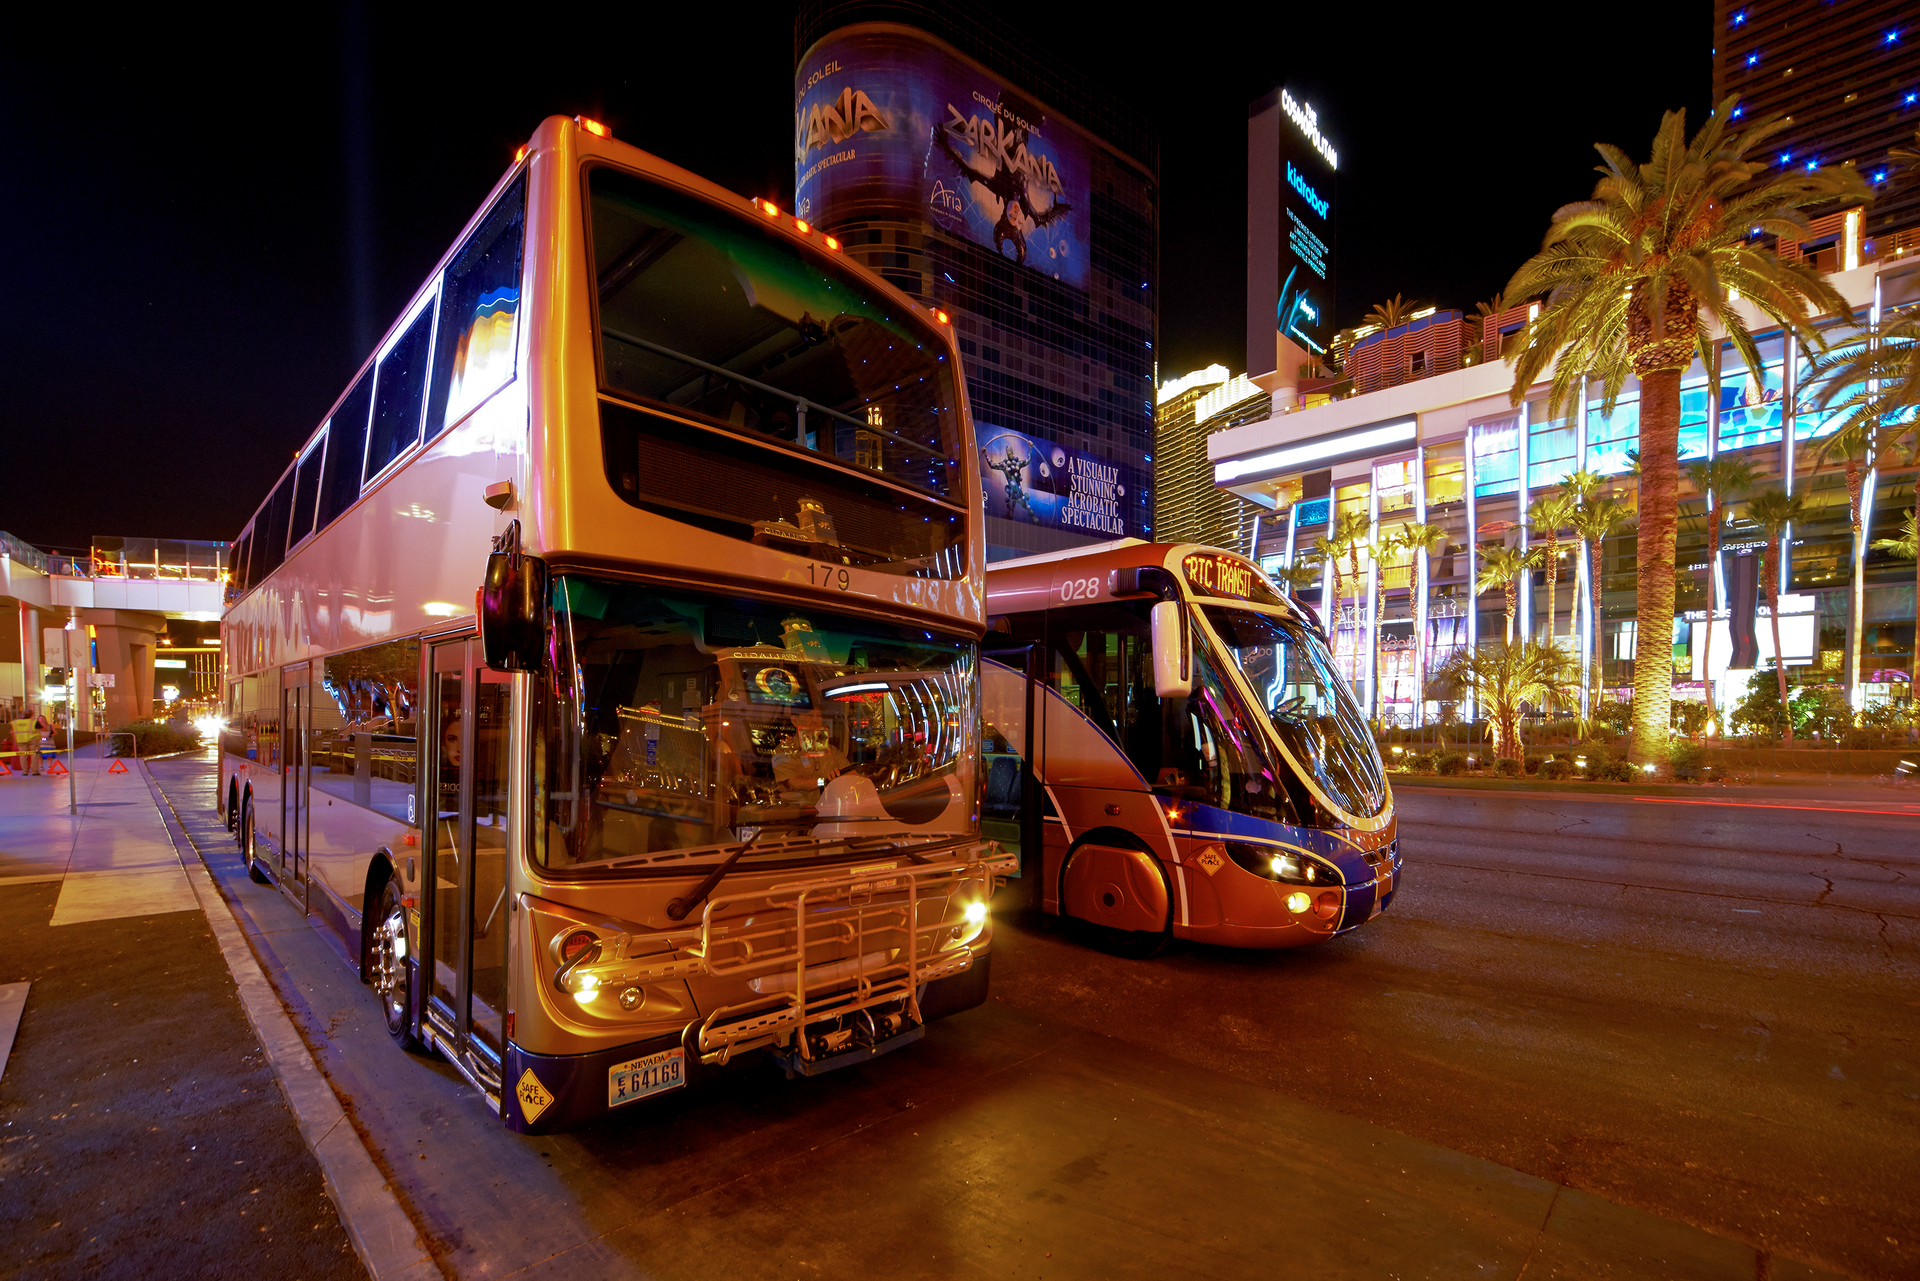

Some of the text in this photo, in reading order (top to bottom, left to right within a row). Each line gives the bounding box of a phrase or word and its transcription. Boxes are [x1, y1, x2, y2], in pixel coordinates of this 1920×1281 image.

[808, 60, 842, 90] SOLEIL
[973, 91, 1042, 138] CIRQUE DU SOLEIL
[1281, 88, 1337, 172] COSMOPOLITAN
[817, 149, 856, 172] SPECTACULAR
[943, 103, 1065, 196] ZARKANA
[930, 179, 962, 212] Aria
[1287, 160, 1329, 220] kidrobot
[1068, 456, 1119, 485] A VISUALLY
[1070, 473, 1116, 500] STUNNING
[1067, 491, 1119, 518] ACROBATIC
[1061, 506, 1124, 535] SPECTACULAR
[807, 563, 849, 591] 179
[1060, 577, 1100, 601] 028
[1189, 556, 1252, 598] RTC TRANSIT
[630, 1054, 666, 1071] NEVADA
[631, 1061, 679, 1093] 64169
[521, 1081, 539, 1096] SAFE
